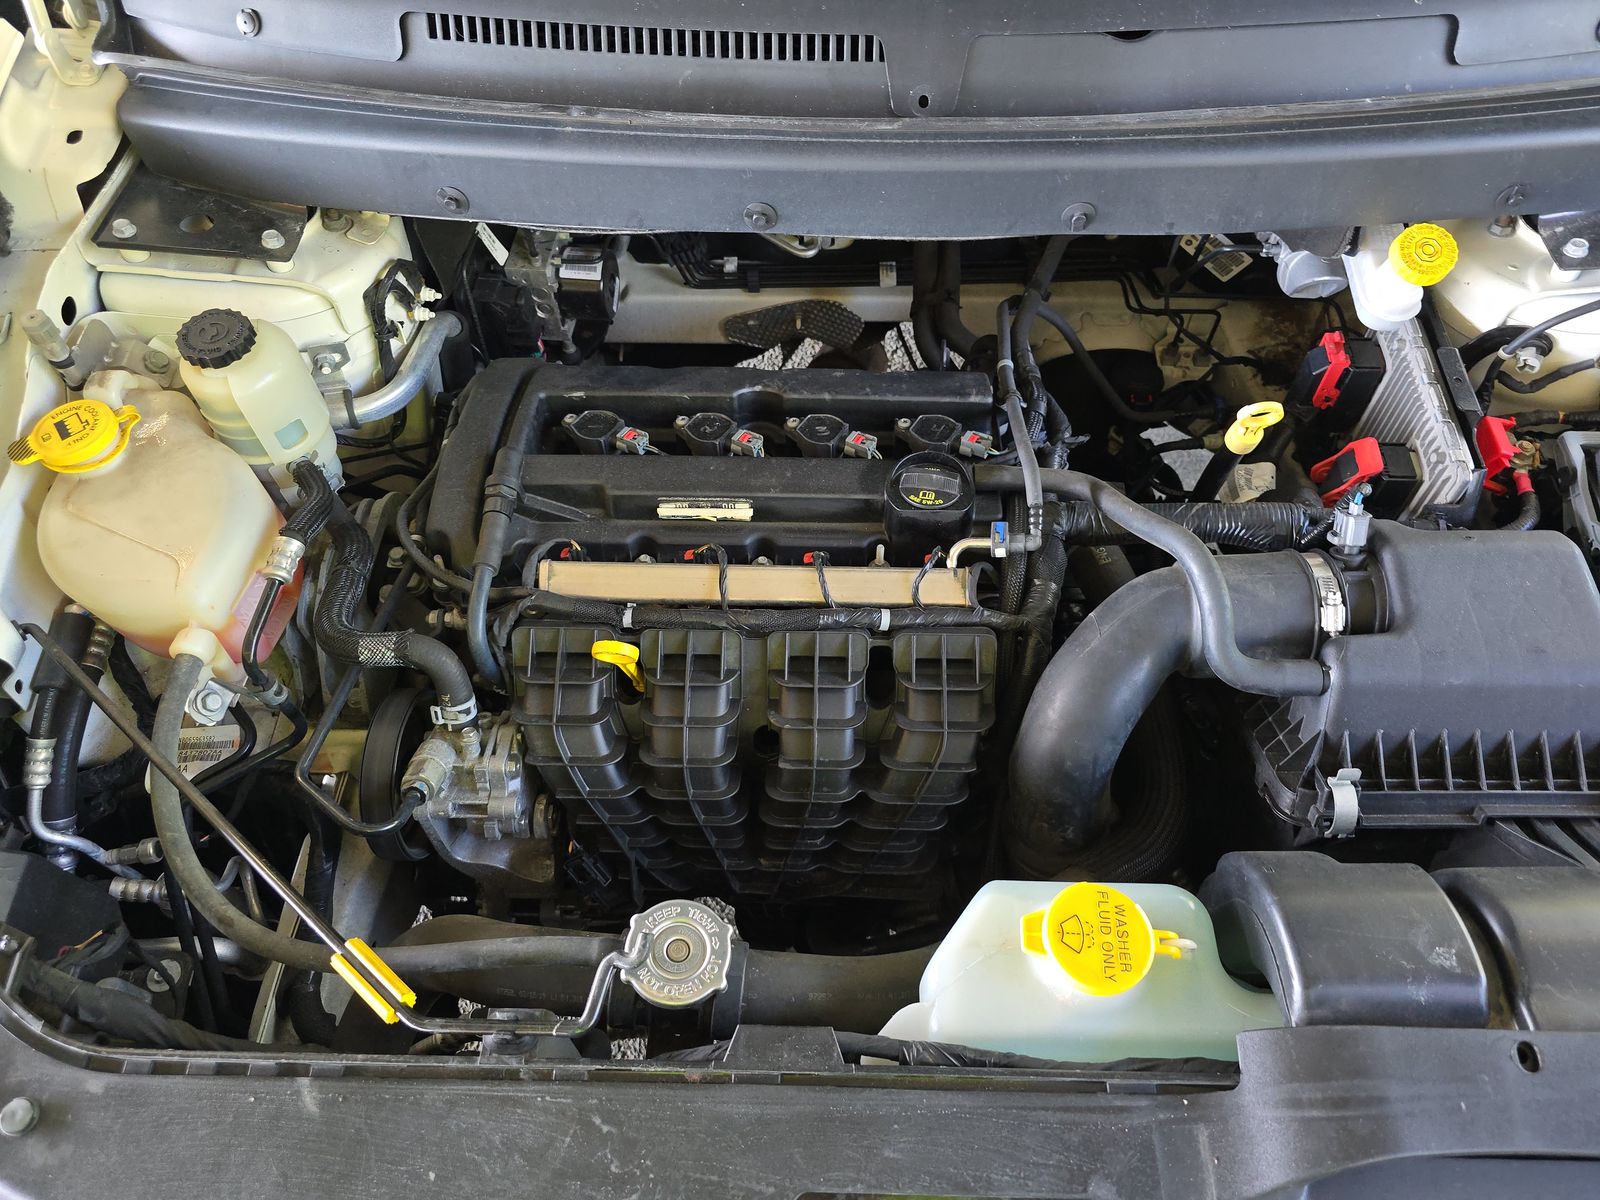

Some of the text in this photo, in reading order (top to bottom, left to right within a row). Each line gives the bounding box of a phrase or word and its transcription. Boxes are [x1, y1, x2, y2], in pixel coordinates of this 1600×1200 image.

[51, 406, 82, 419] ENGINE
[84, 406, 100, 431] COOLANT
[908, 494, 921, 503] SAE
[645, 906, 719, 933] KEEP TIGHT
[1096, 890, 1117, 983] FLUID ONLY
[1114, 904, 1132, 973] WASHER
[637, 967, 663, 991] NOT
[664, 979, 702, 996] OPEN
[701, 955, 722, 983] HOT
